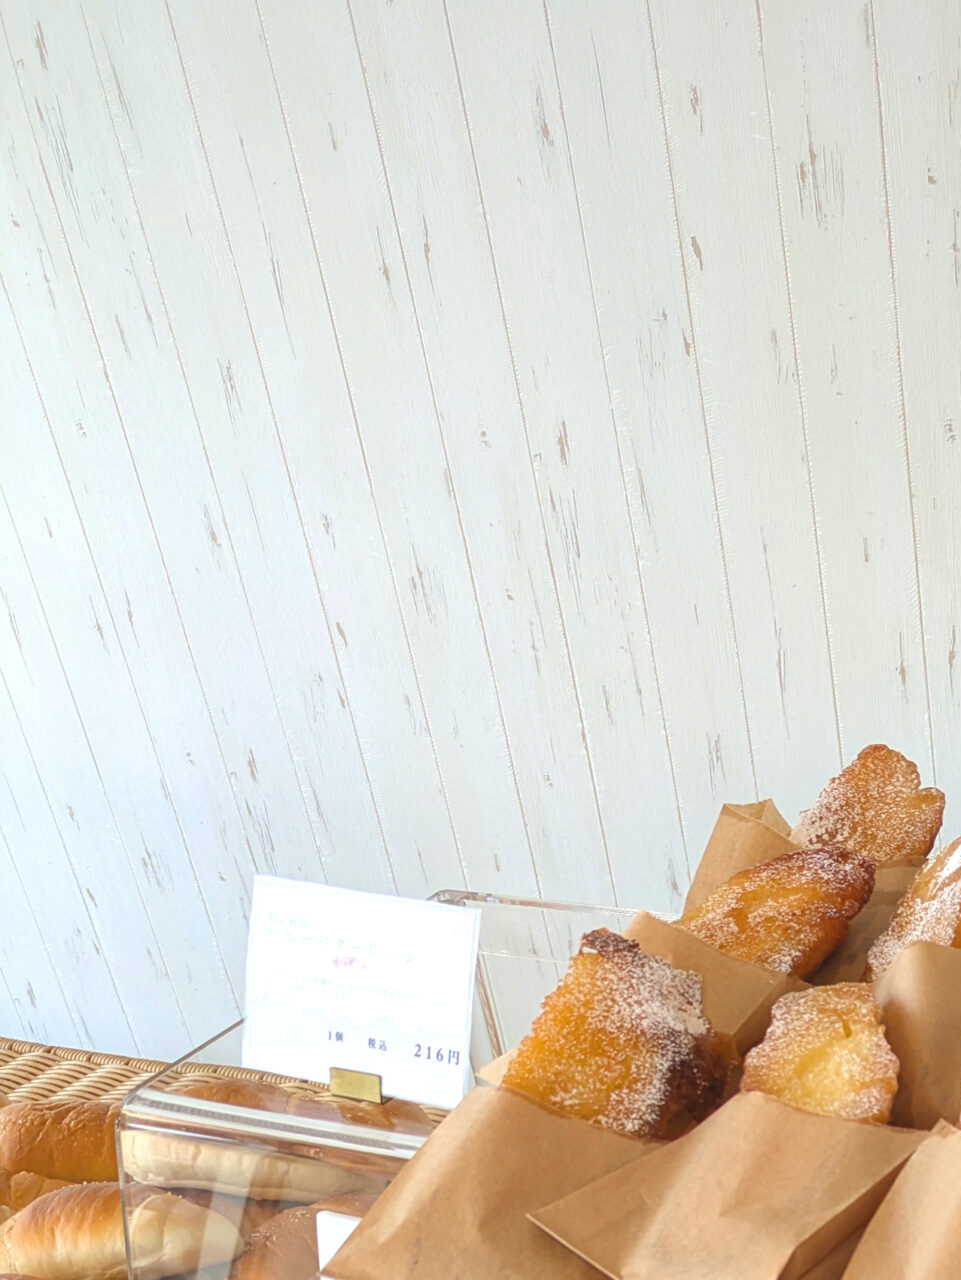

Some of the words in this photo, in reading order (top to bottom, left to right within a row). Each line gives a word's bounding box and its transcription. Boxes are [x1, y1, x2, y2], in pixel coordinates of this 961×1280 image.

[328, 1030, 344, 1043] 1個
[367, 1037, 388, 1051] 税込
[414, 1043, 460, 1066] 216円
